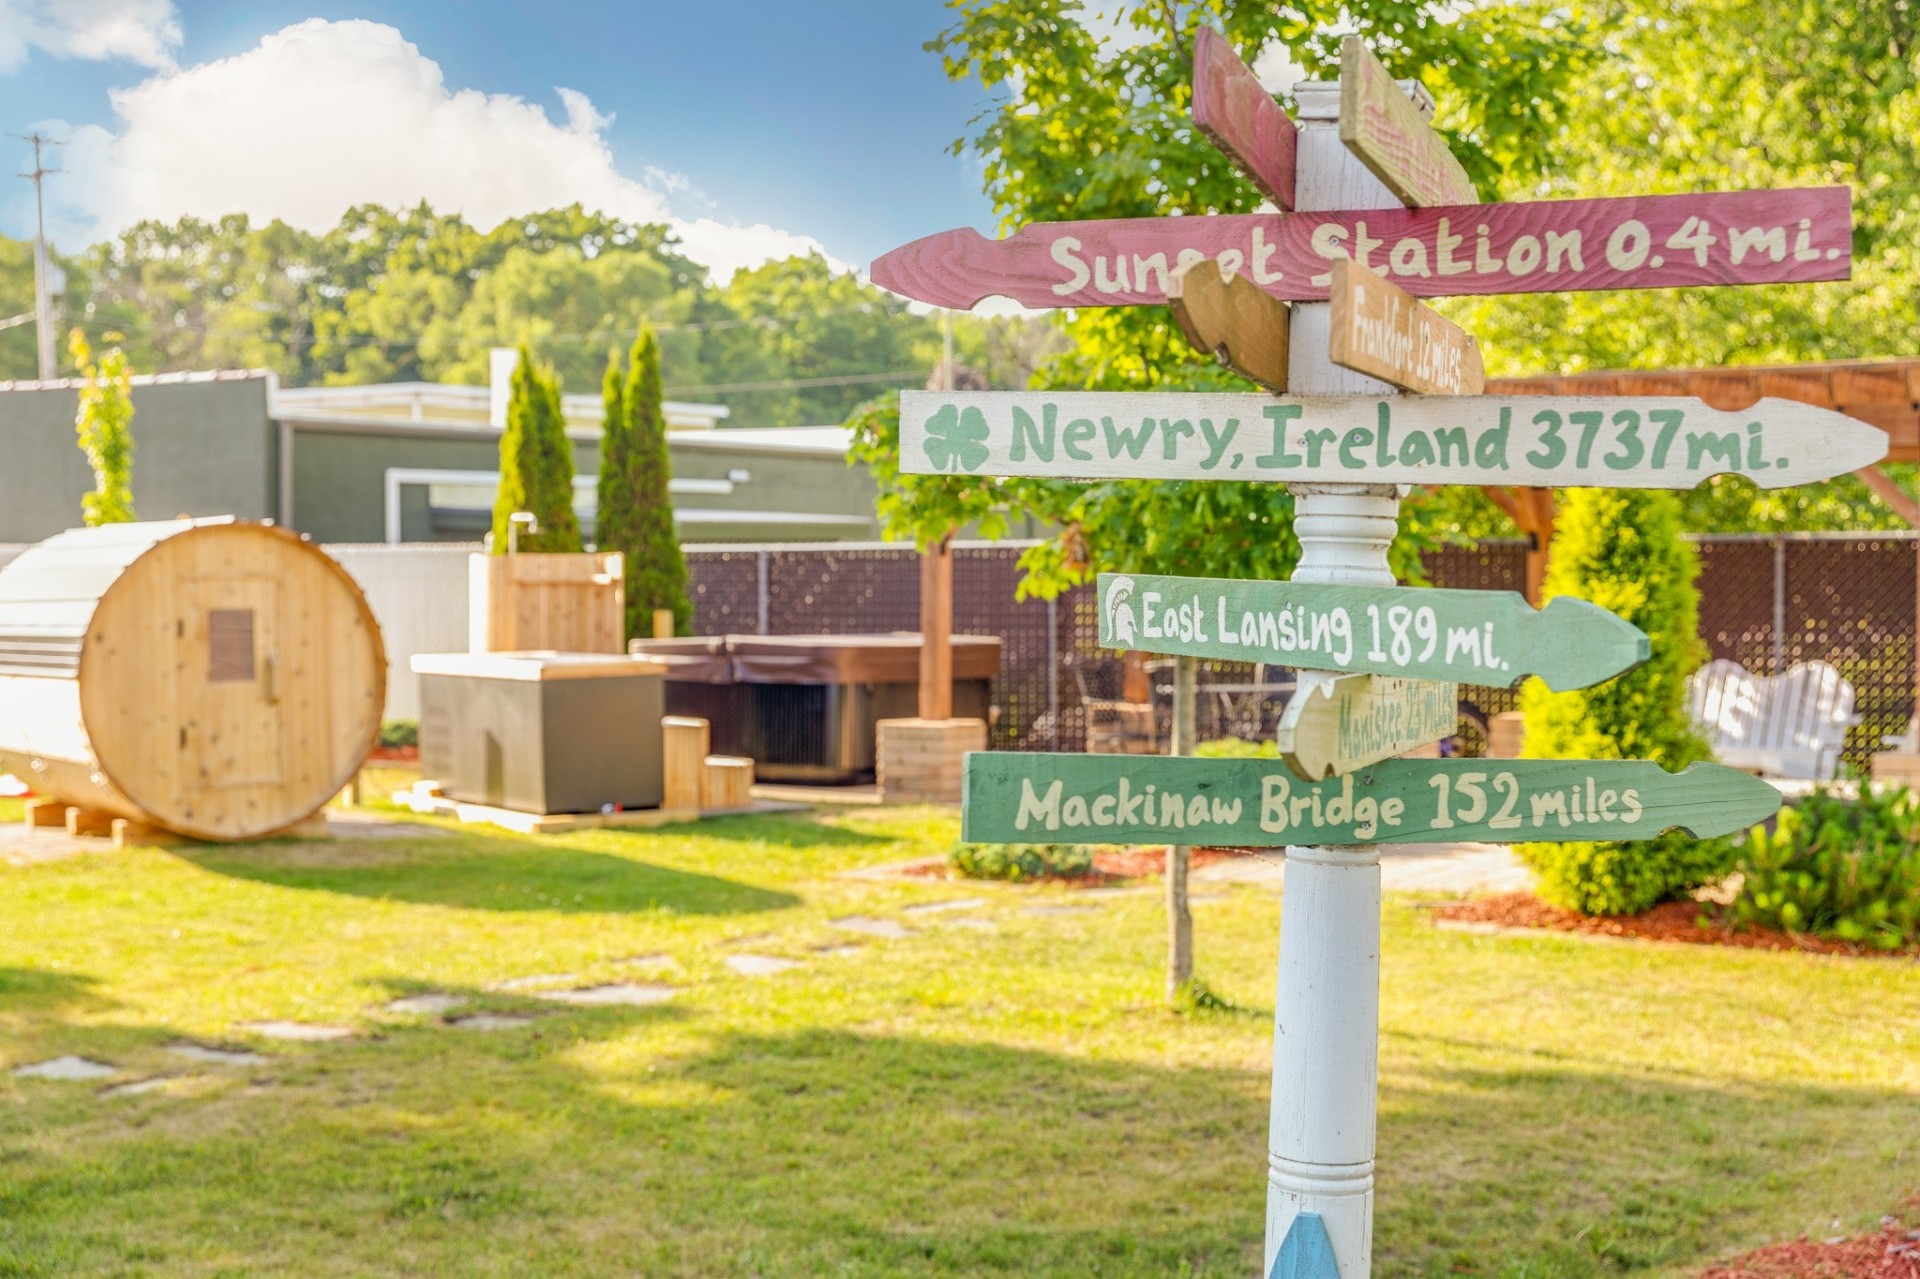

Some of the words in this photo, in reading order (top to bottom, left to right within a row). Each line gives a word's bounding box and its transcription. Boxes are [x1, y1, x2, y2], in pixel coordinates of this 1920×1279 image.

[1310, 218, 1585, 288] Station
[1606, 216, 1717, 272] 0.4
[1728, 217, 1840, 265] mi.
[1352, 285, 1413, 373] Frankfort
[1432, 328, 1461, 395] miles
[1010, 402, 1244, 470] Newry,
[1255, 400, 1511, 471] Ireland
[1525, 408, 1685, 471] 3737
[1685, 421, 1790, 471] mi.
[1143, 591, 1207, 643] East
[1218, 596, 1353, 667] Lansing
[1367, 603, 1438, 668] 189
[1446, 621, 1510, 671] mi.
[1338, 685, 1402, 760] Manistee
[1015, 777, 1243, 831] Mackinaw
[1259, 773, 1405, 839] Bridge
[1428, 772, 1523, 829] 152
[1530, 776, 1643, 828] miles
